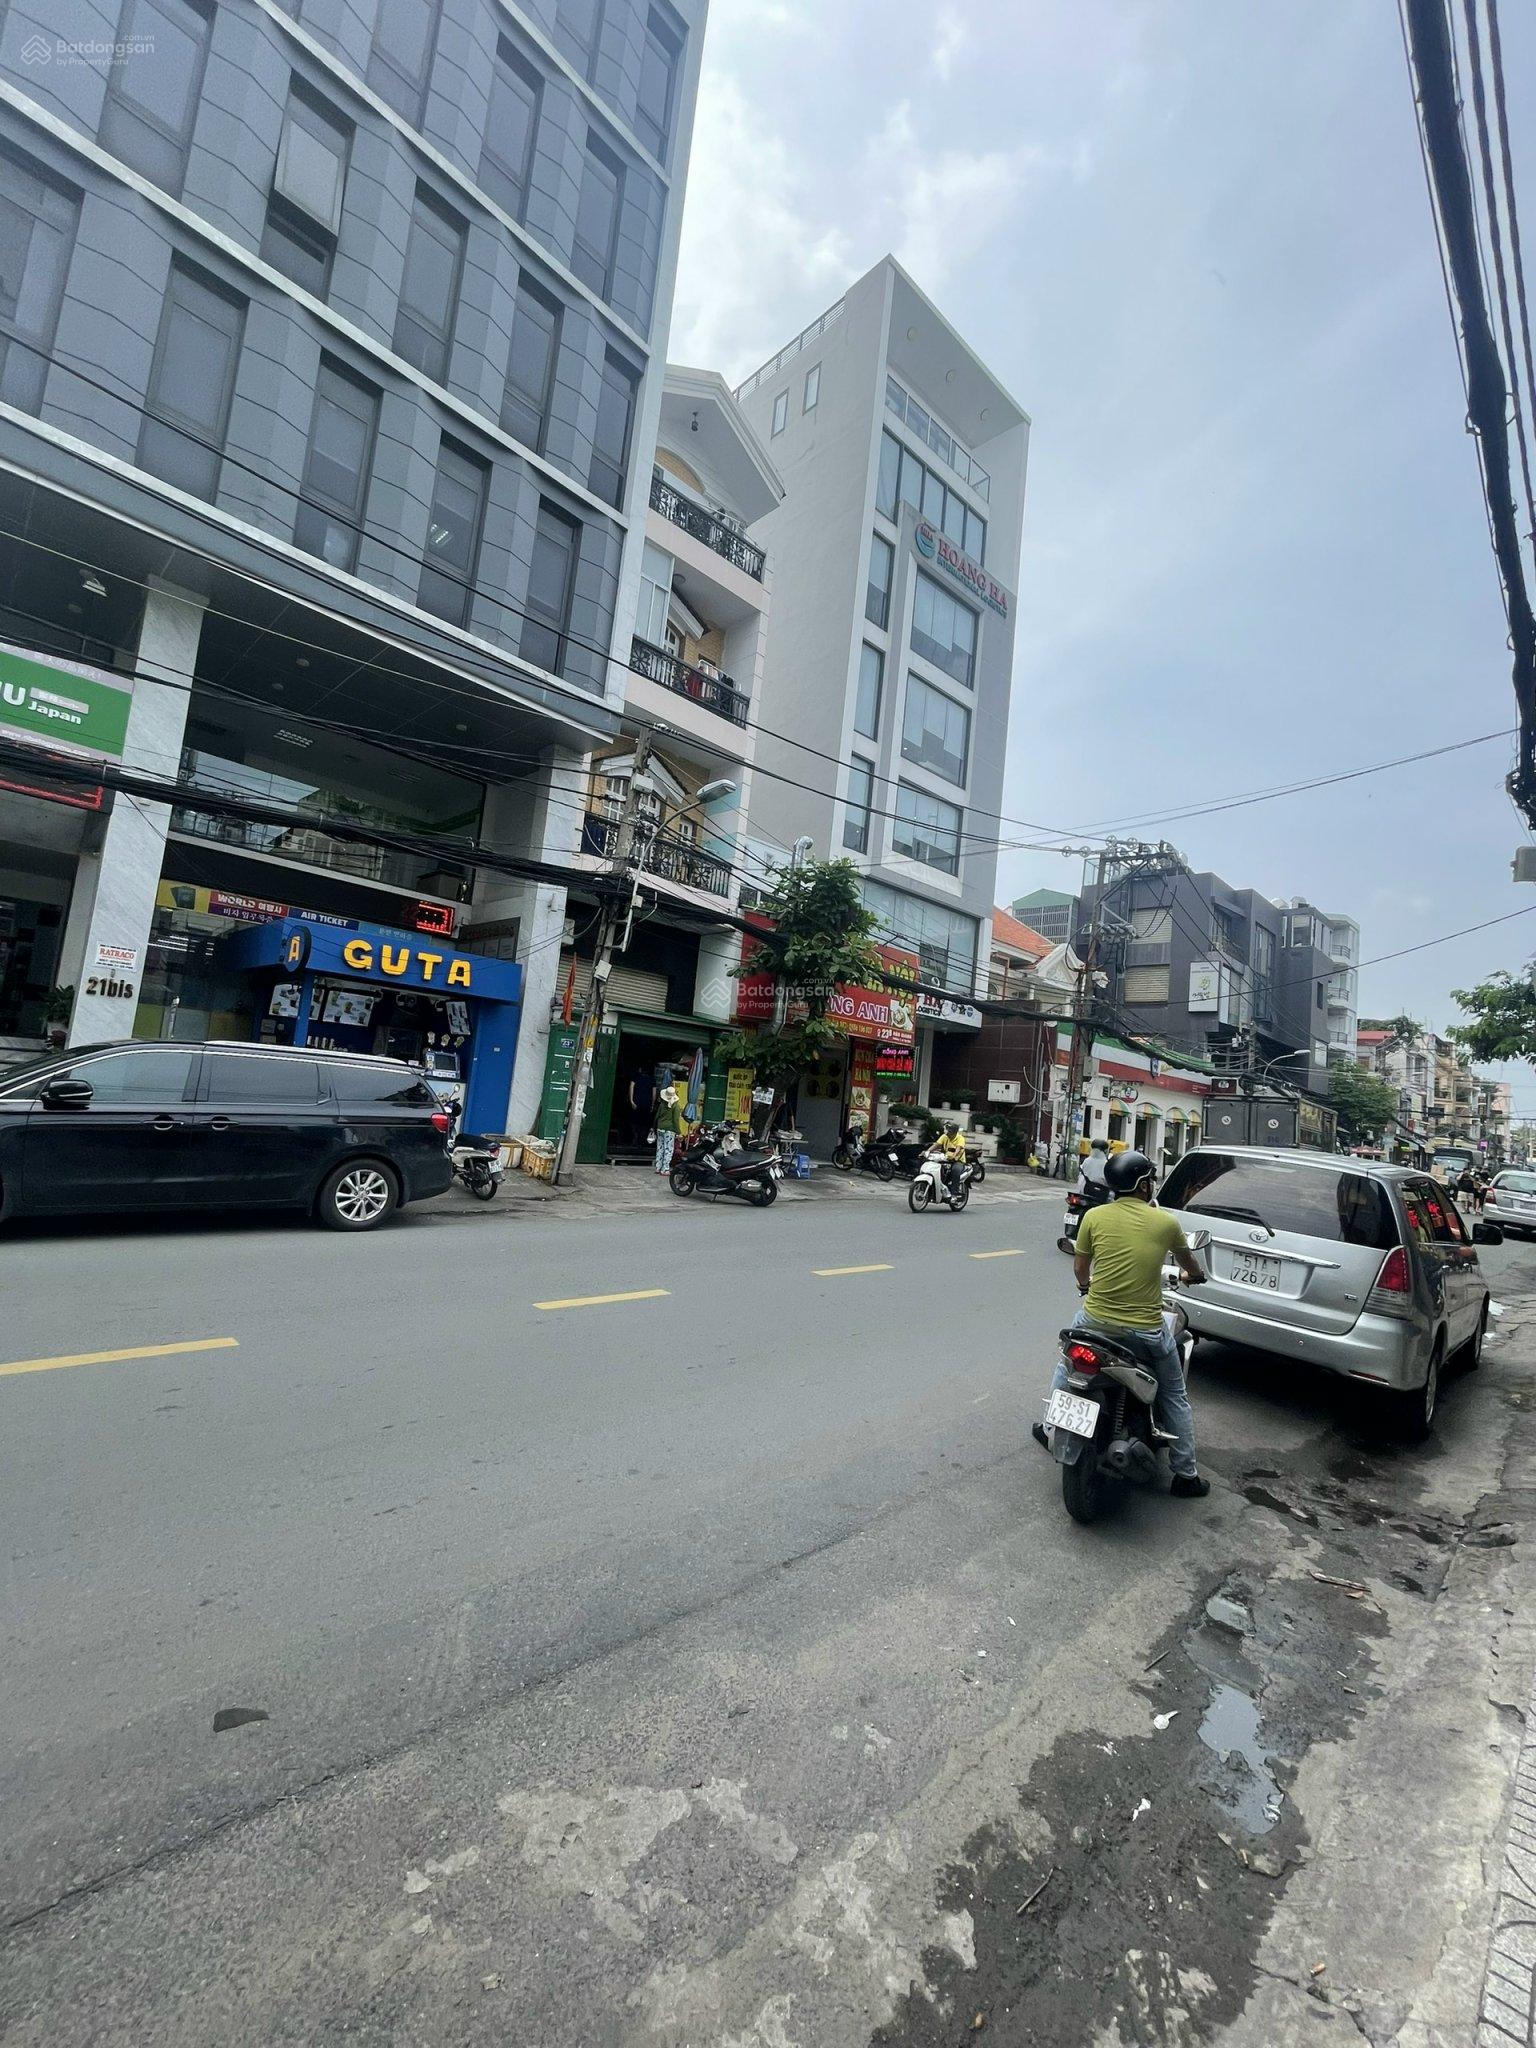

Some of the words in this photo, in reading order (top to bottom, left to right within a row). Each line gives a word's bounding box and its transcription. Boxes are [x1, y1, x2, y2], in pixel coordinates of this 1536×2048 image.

[0, 682, 26, 705] U
[28, 702, 81, 724] Japan
[217, 894, 255, 908] WORLD
[300, 911, 317, 921] AIR
[319, 915, 349, 927] TICKET
[99, 947, 135, 960] RATRACO
[344, 939, 472, 987] GUTA
[86, 976, 134, 999] 21bis
[828, 994, 855, 1016] NG
[857, 1001, 889, 1023] ANH
[1244, 1255, 1268, 1271] 51A
[1233, 1267, 1277, 1288] 726.78
[1058, 1394, 1091, 1417] 59-S1
[1049, 1407, 1092, 1433] 476.27
